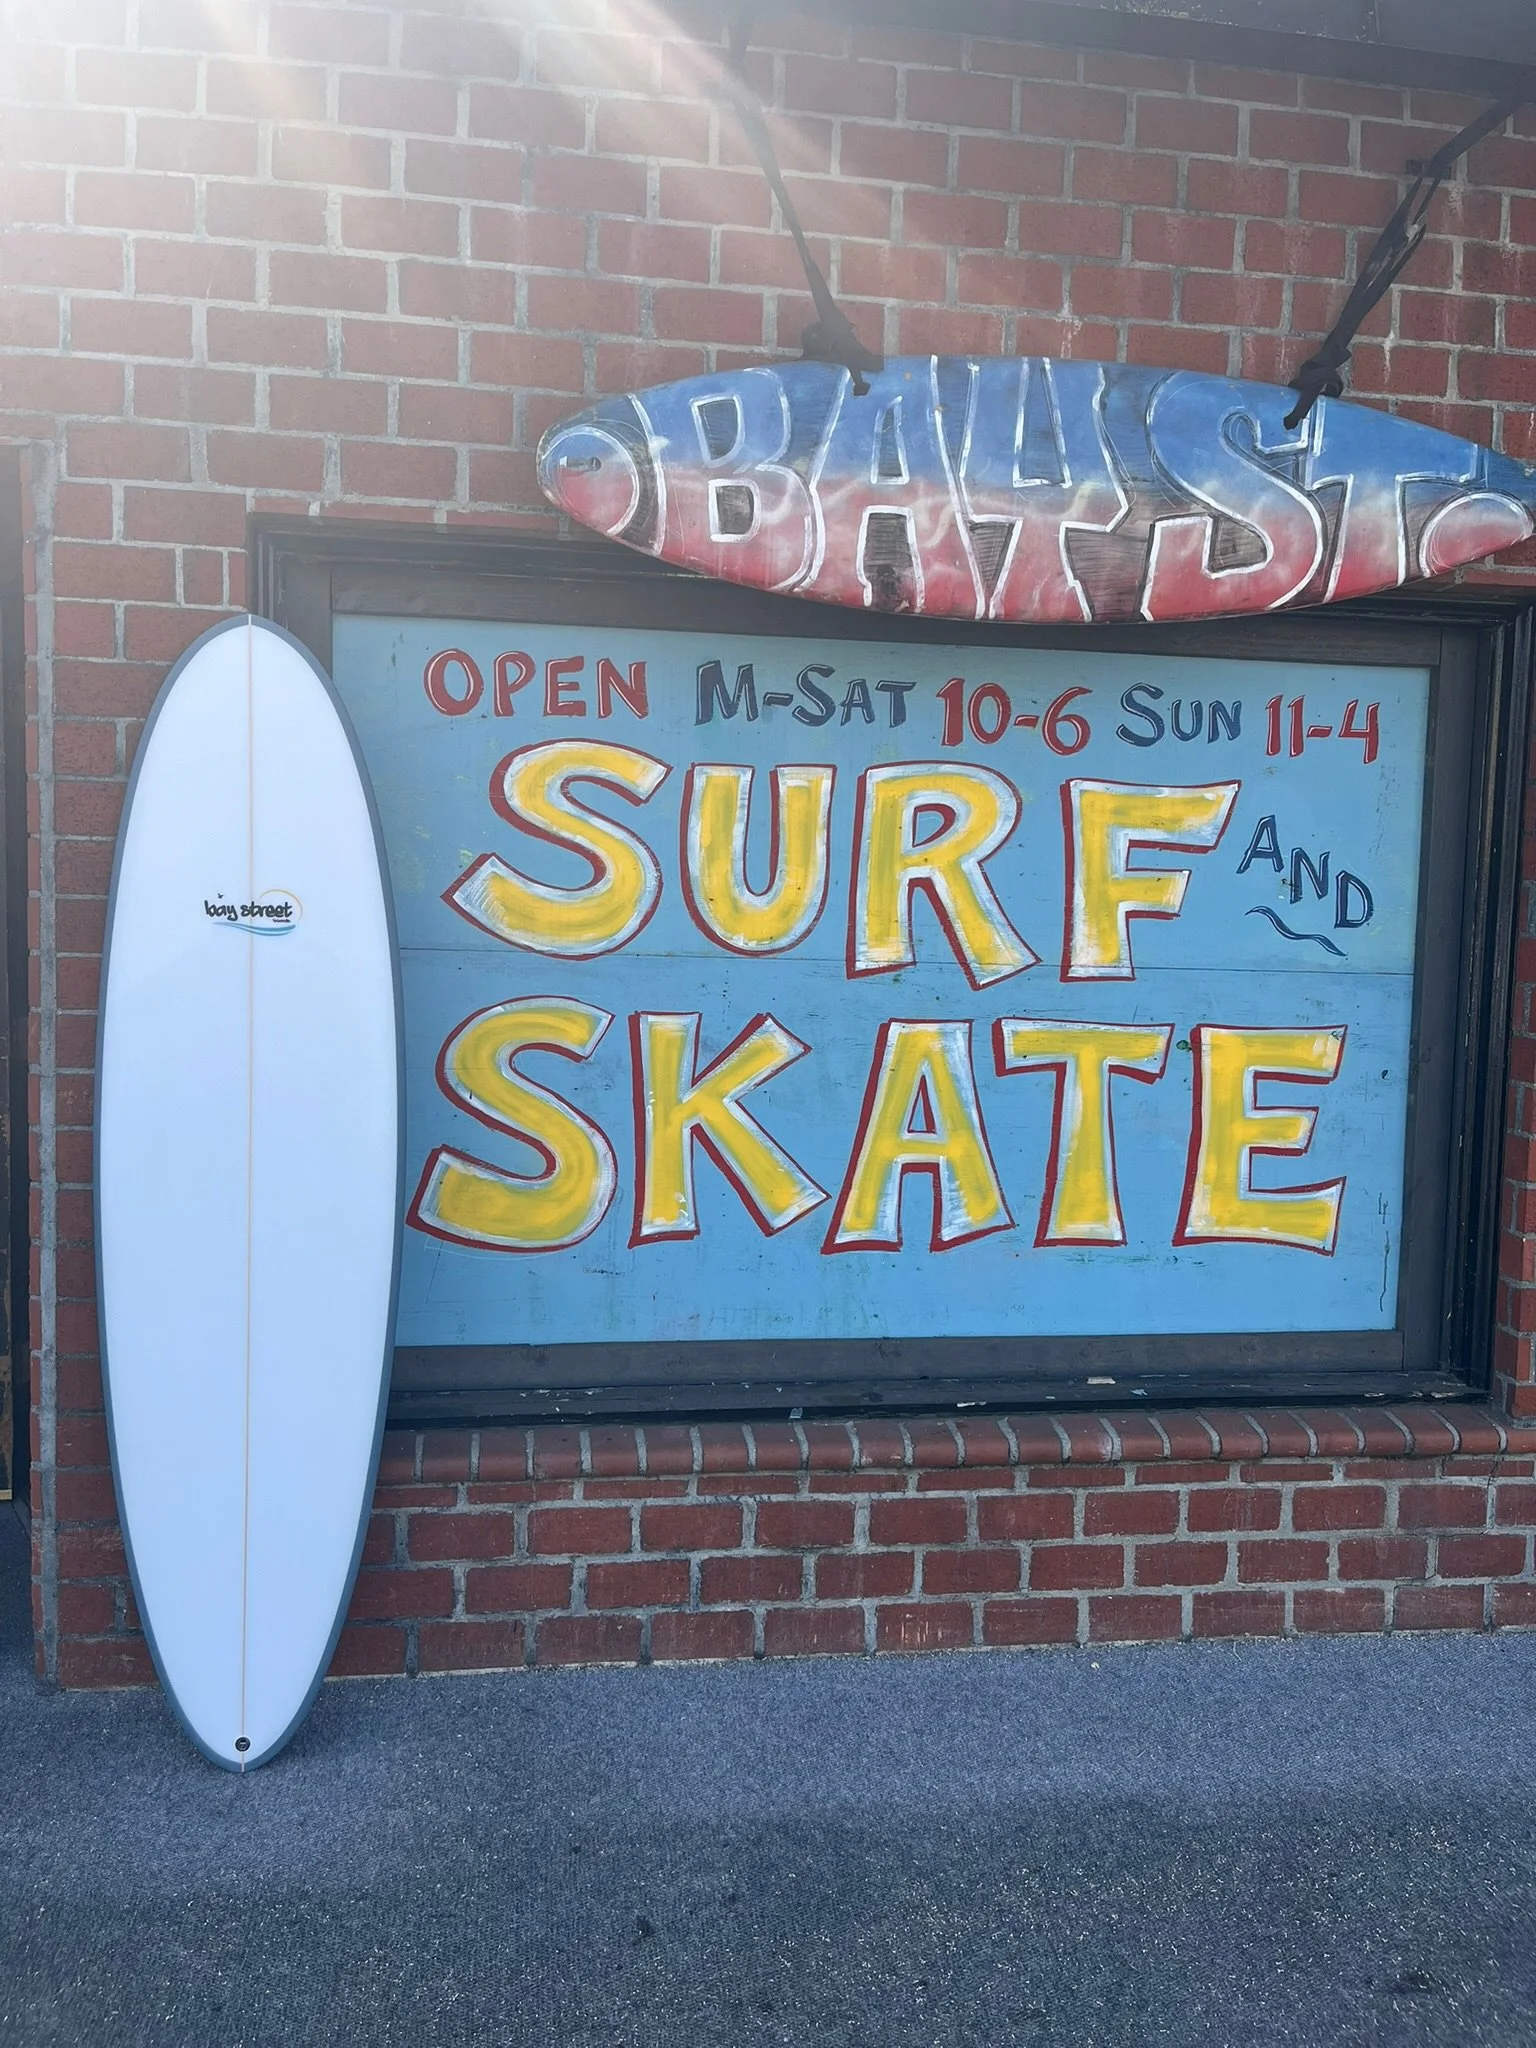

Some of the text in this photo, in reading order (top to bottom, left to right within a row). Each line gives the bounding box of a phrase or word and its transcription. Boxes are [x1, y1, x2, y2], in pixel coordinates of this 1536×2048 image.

[423, 648, 1382, 765] OPEN M-SAT 10-6 SUN 11-4
[204, 899, 293, 922] bay street
[440, 740, 1374, 990] SURF AND
[409, 995, 1348, 1256] SKATE
